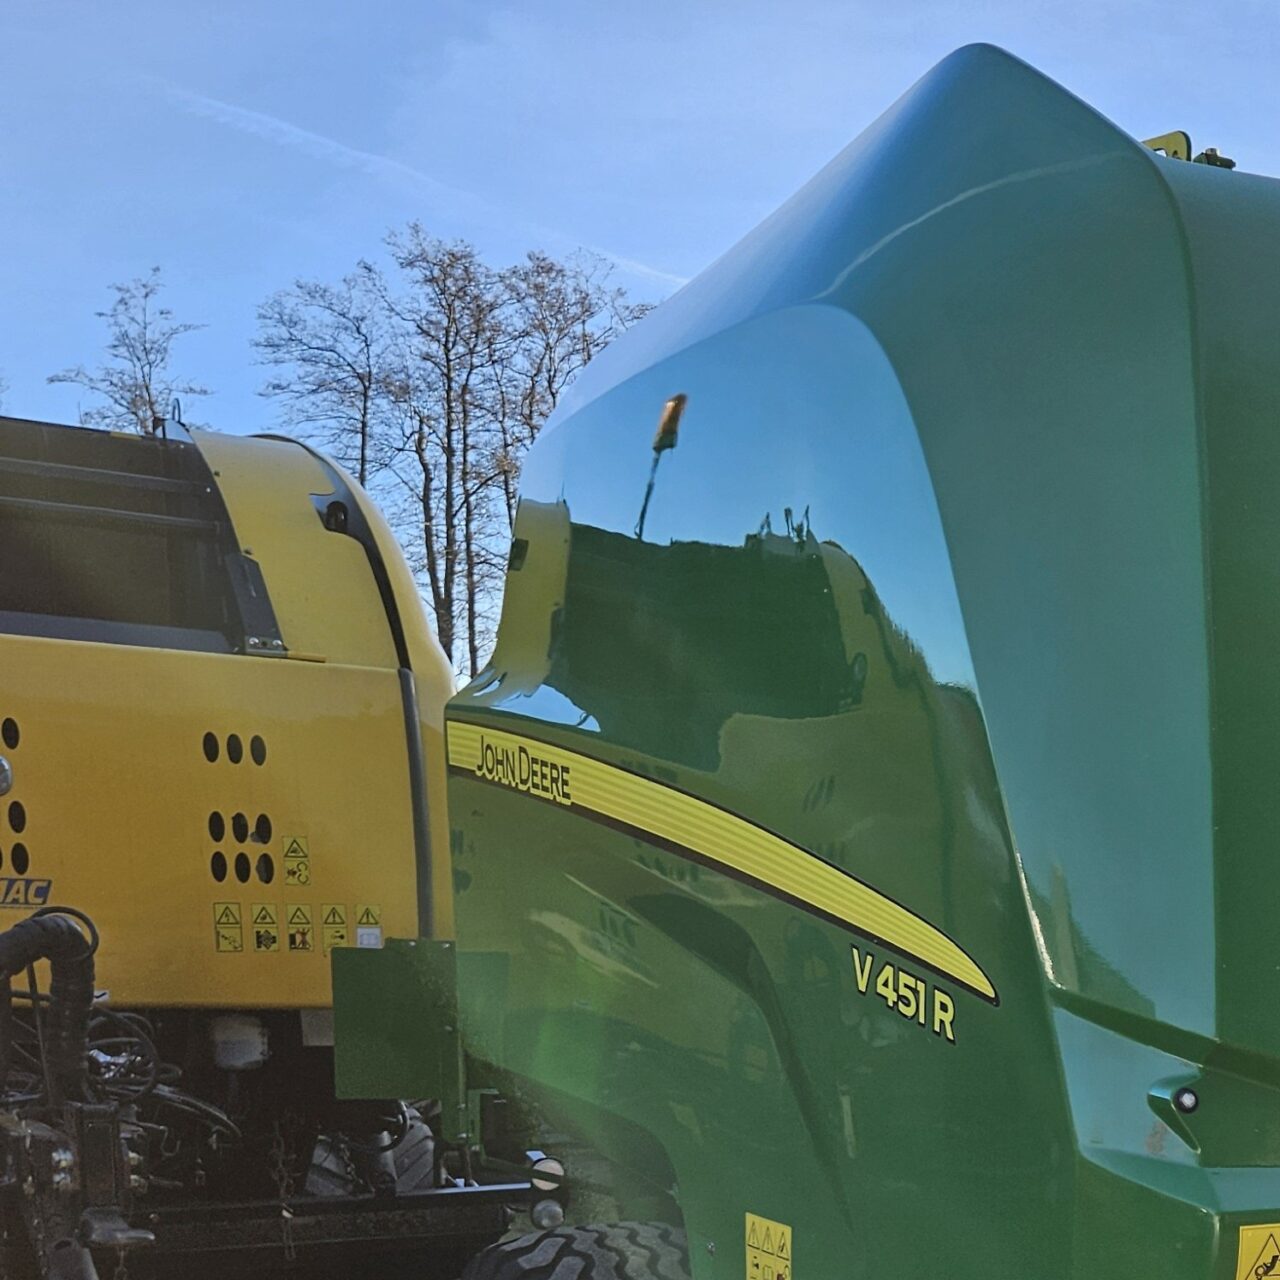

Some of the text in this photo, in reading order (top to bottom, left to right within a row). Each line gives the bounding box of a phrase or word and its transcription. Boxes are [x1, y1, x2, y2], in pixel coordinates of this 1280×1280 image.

[477, 734, 572, 801] JOHN DEERE
[0, 879, 49, 904] AC
[876, 963, 926, 1025] 451
